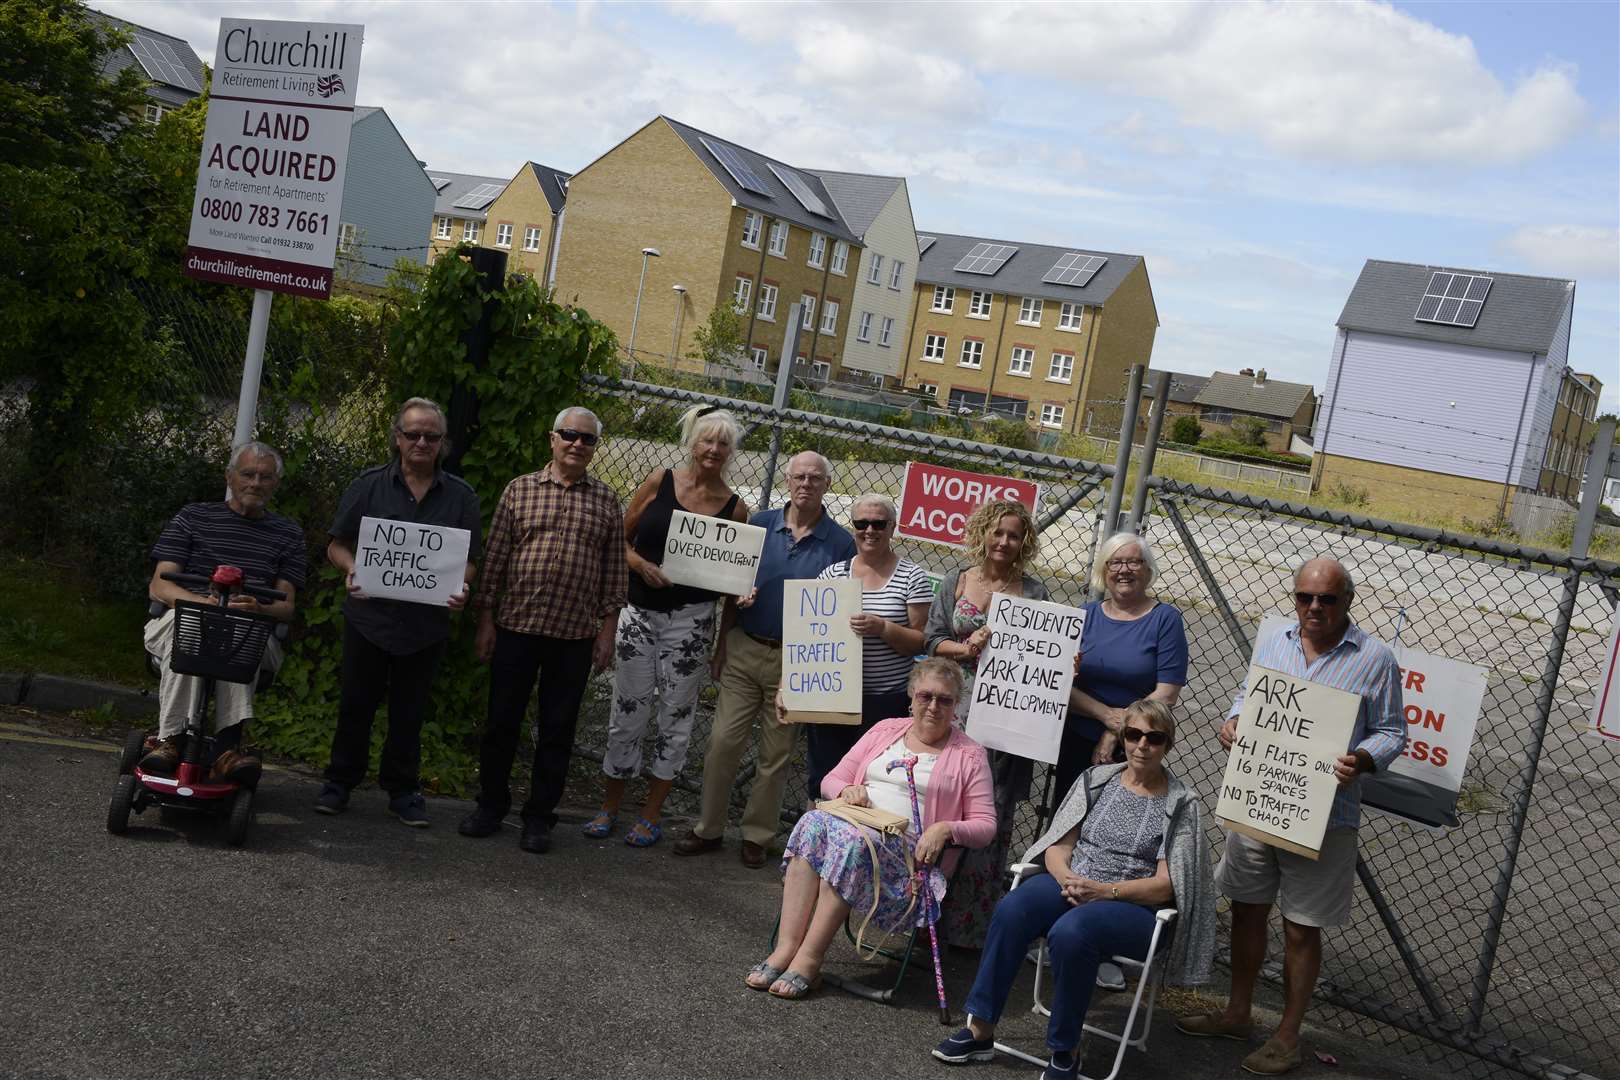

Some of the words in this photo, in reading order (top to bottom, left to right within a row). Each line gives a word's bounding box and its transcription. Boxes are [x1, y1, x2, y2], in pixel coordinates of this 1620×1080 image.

[224, 27, 347, 70] Churchill
[222, 71, 279, 89] Retirement
[282, 77, 315, 97] Living
[242, 110, 310, 142] LAND
[208, 142, 336, 182] ACQUIRED
[209, 176, 222, 189] for
[223, 178, 271, 195] Retirement
[200, 197, 243, 222] 0800
[248, 204, 280, 228] 783
[286, 209, 329, 235] 7661
[260, 236, 272, 245] Call
[188, 255, 327, 292] churchillretirement.co.uk
[922, 472, 1020, 505] WORKS
[373, 523, 407, 546] NO
[418, 529, 443, 551] TO
[679, 516, 707, 539] NO
[715, 523, 737, 544] TO
[362, 546, 429, 571] TRAFFIC
[382, 570, 438, 589] CHAOS
[800, 587, 837, 617] NO
[810, 622, 828, 636] TO
[995, 598, 1083, 641] RESIDENTS
[787, 642, 847, 664] TRAFFIC
[989, 630, 1062, 659] OPPOSED
[789, 671, 842, 693] CHAOS
[980, 656, 1020, 683] ARK
[1021, 664, 1063, 691] LANE
[976, 682, 1067, 721] DEVELOPMENT
[1249, 675, 1307, 712] ARK
[1255, 706, 1314, 739] LANE
[1237, 735, 1257, 756] 41
[1264, 744, 1307, 768] FLATS
[1236, 758, 1252, 774] 16
[1257, 763, 1309, 788] PARKING
[1223, 784, 1242, 801] NO
[1245, 790, 1258, 806] TO
[1260, 794, 1310, 822] TRAFFIC
[1259, 780, 1308, 800] SPACES
[1248, 807, 1291, 830] CHAOS
